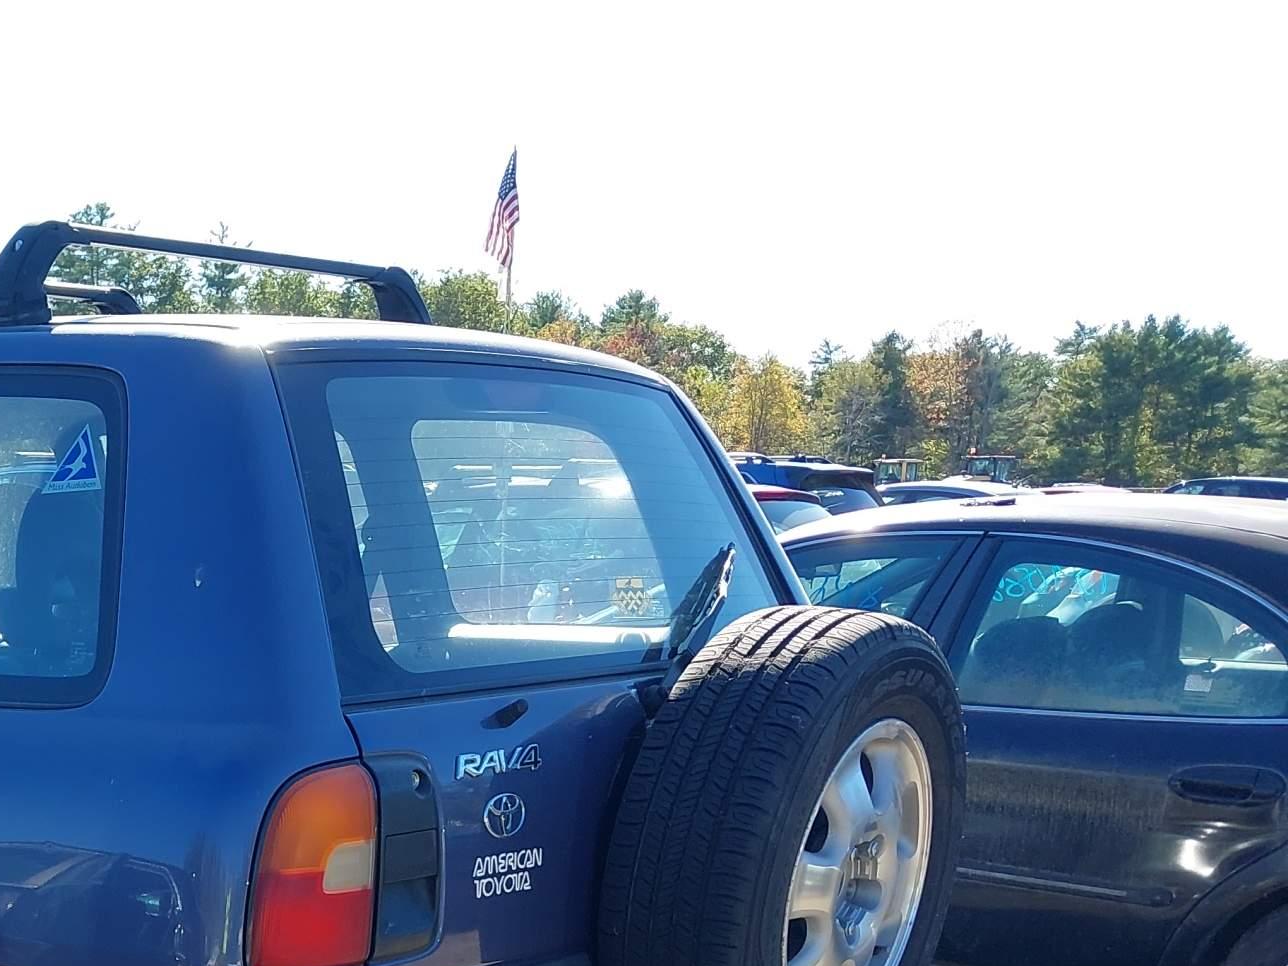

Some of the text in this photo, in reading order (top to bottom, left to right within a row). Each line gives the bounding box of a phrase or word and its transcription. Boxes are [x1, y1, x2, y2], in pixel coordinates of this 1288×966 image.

[455, 743, 542, 780] RAV4
[472, 847, 543, 878] AMERICAN
[473, 870, 532, 899] TOYOTA
